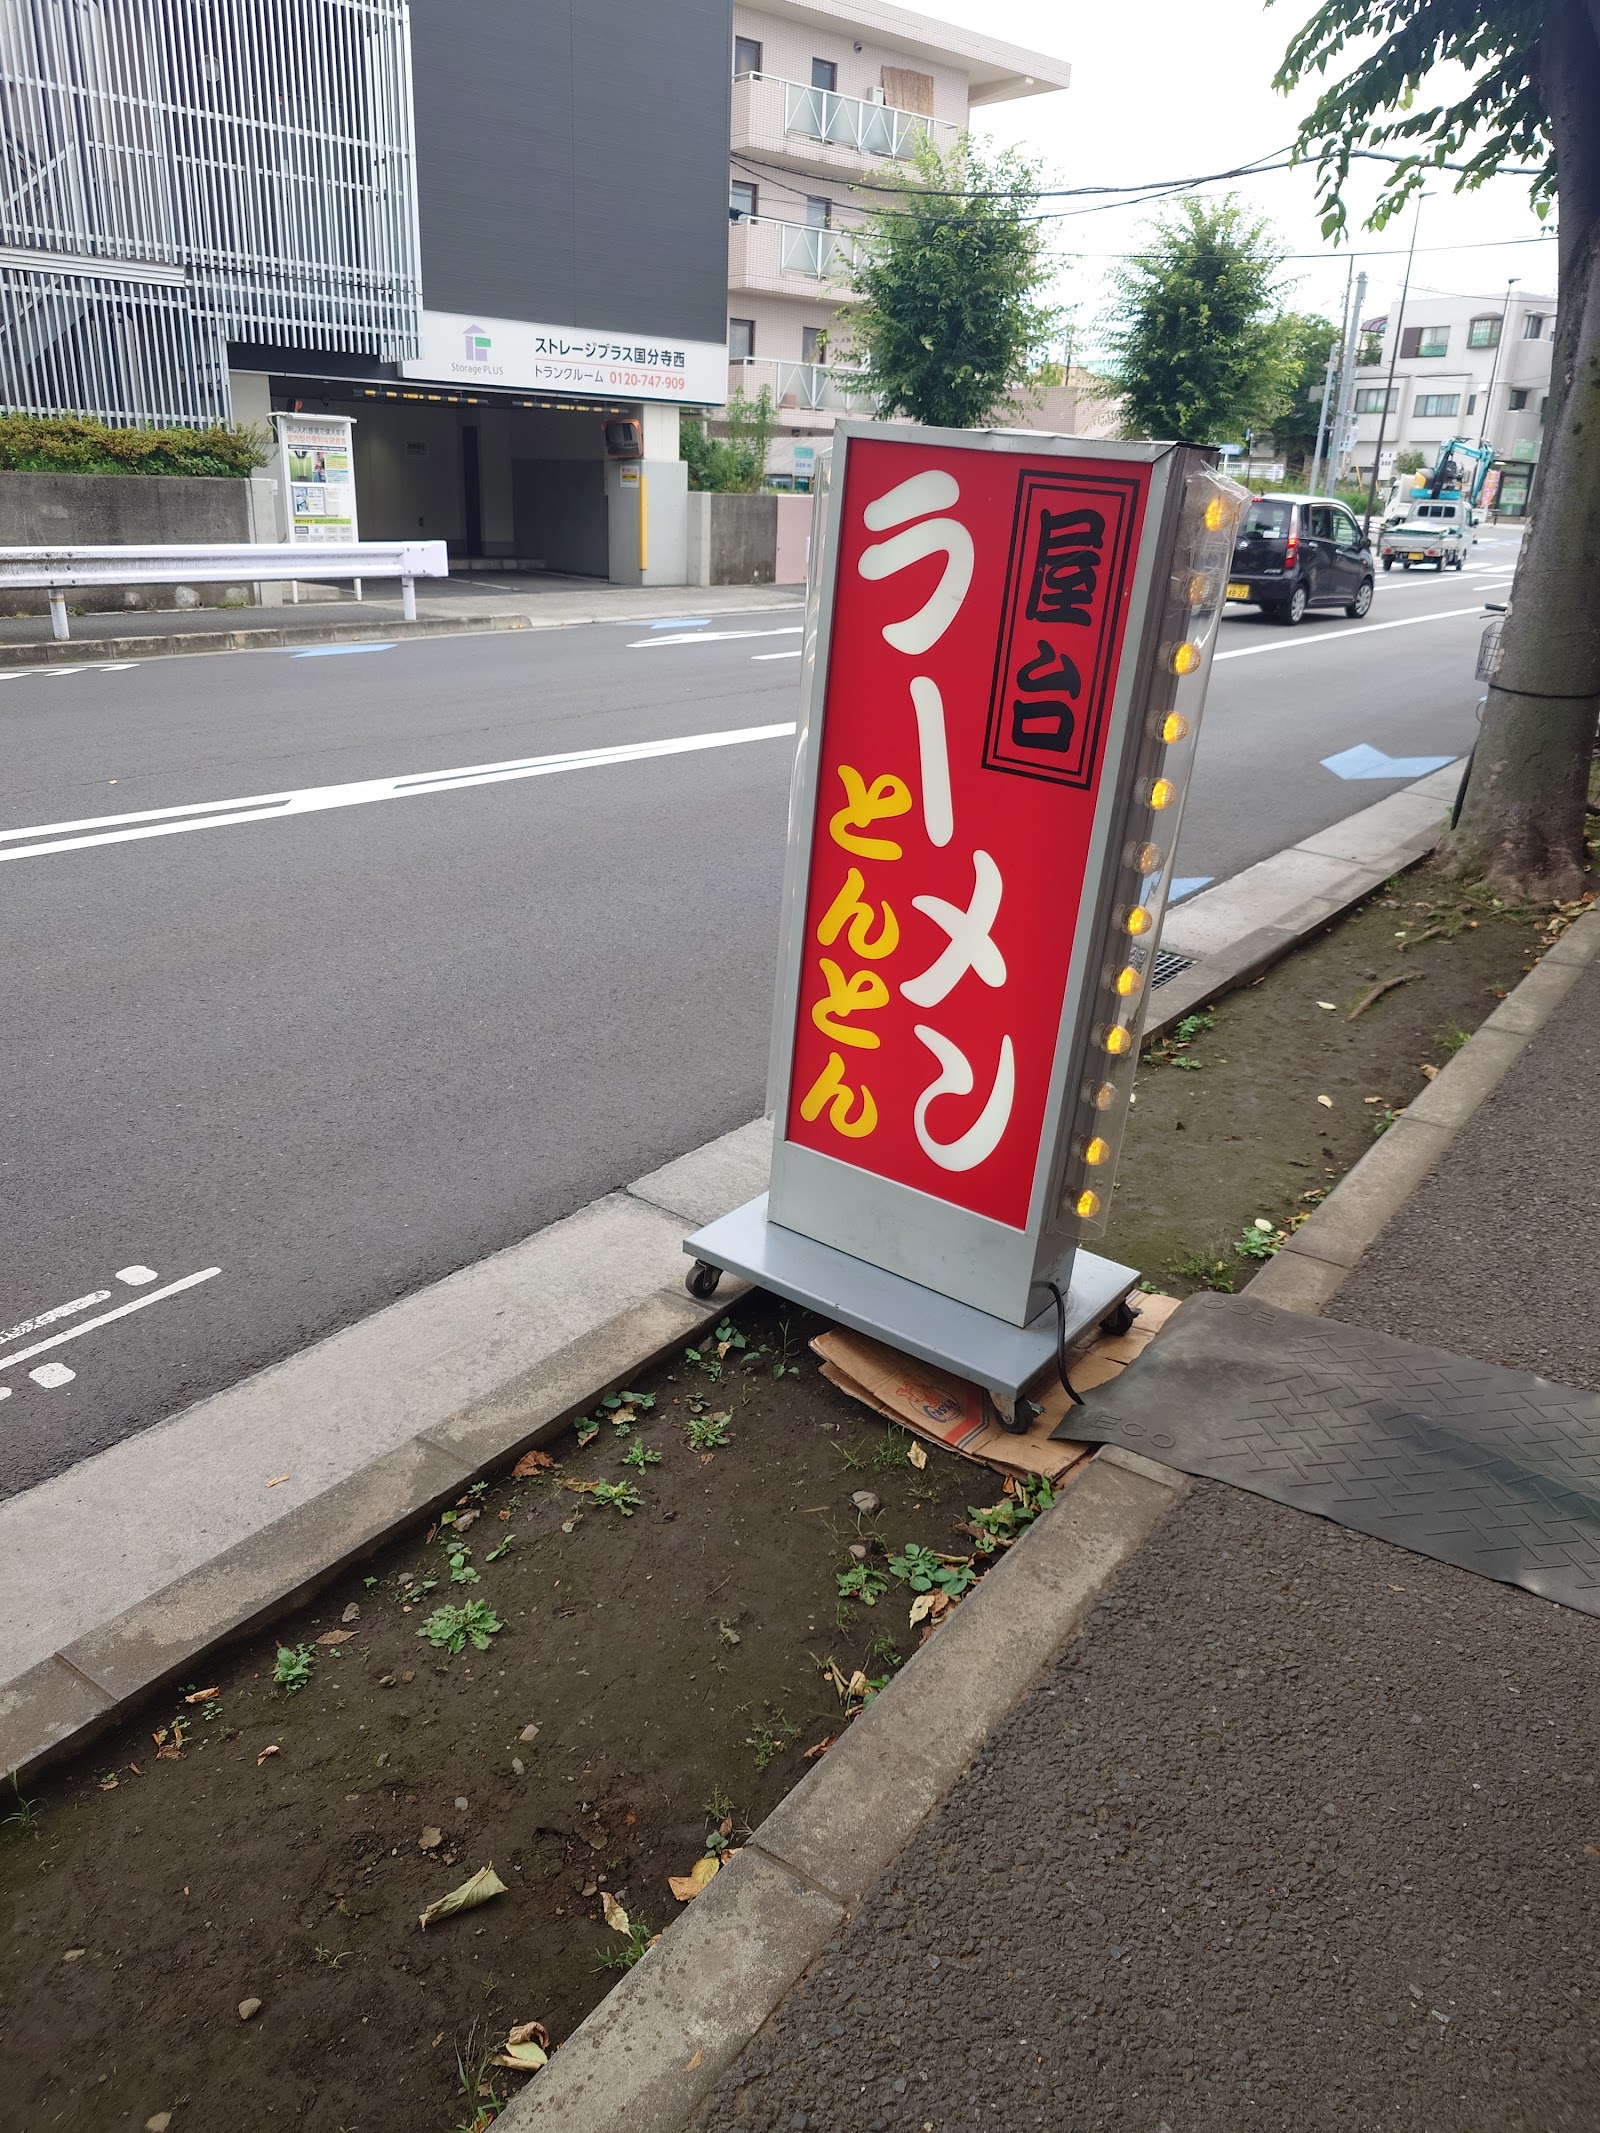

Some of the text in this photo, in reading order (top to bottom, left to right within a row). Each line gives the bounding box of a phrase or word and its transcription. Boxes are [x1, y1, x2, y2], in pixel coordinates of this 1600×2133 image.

[451, 362, 504, 376] Storage PLUS
[535, 337, 685, 369] ストレージプラス国分寺西
[535, 365, 685, 390] トランクルーム 0120-747-909
[1011, 508, 1105, 753] 屋台
[858, 468, 1015, 1172] ラーメン
[800, 763, 913, 1139] とんとん
[1090, 1414, 1177, 1449] ECO
